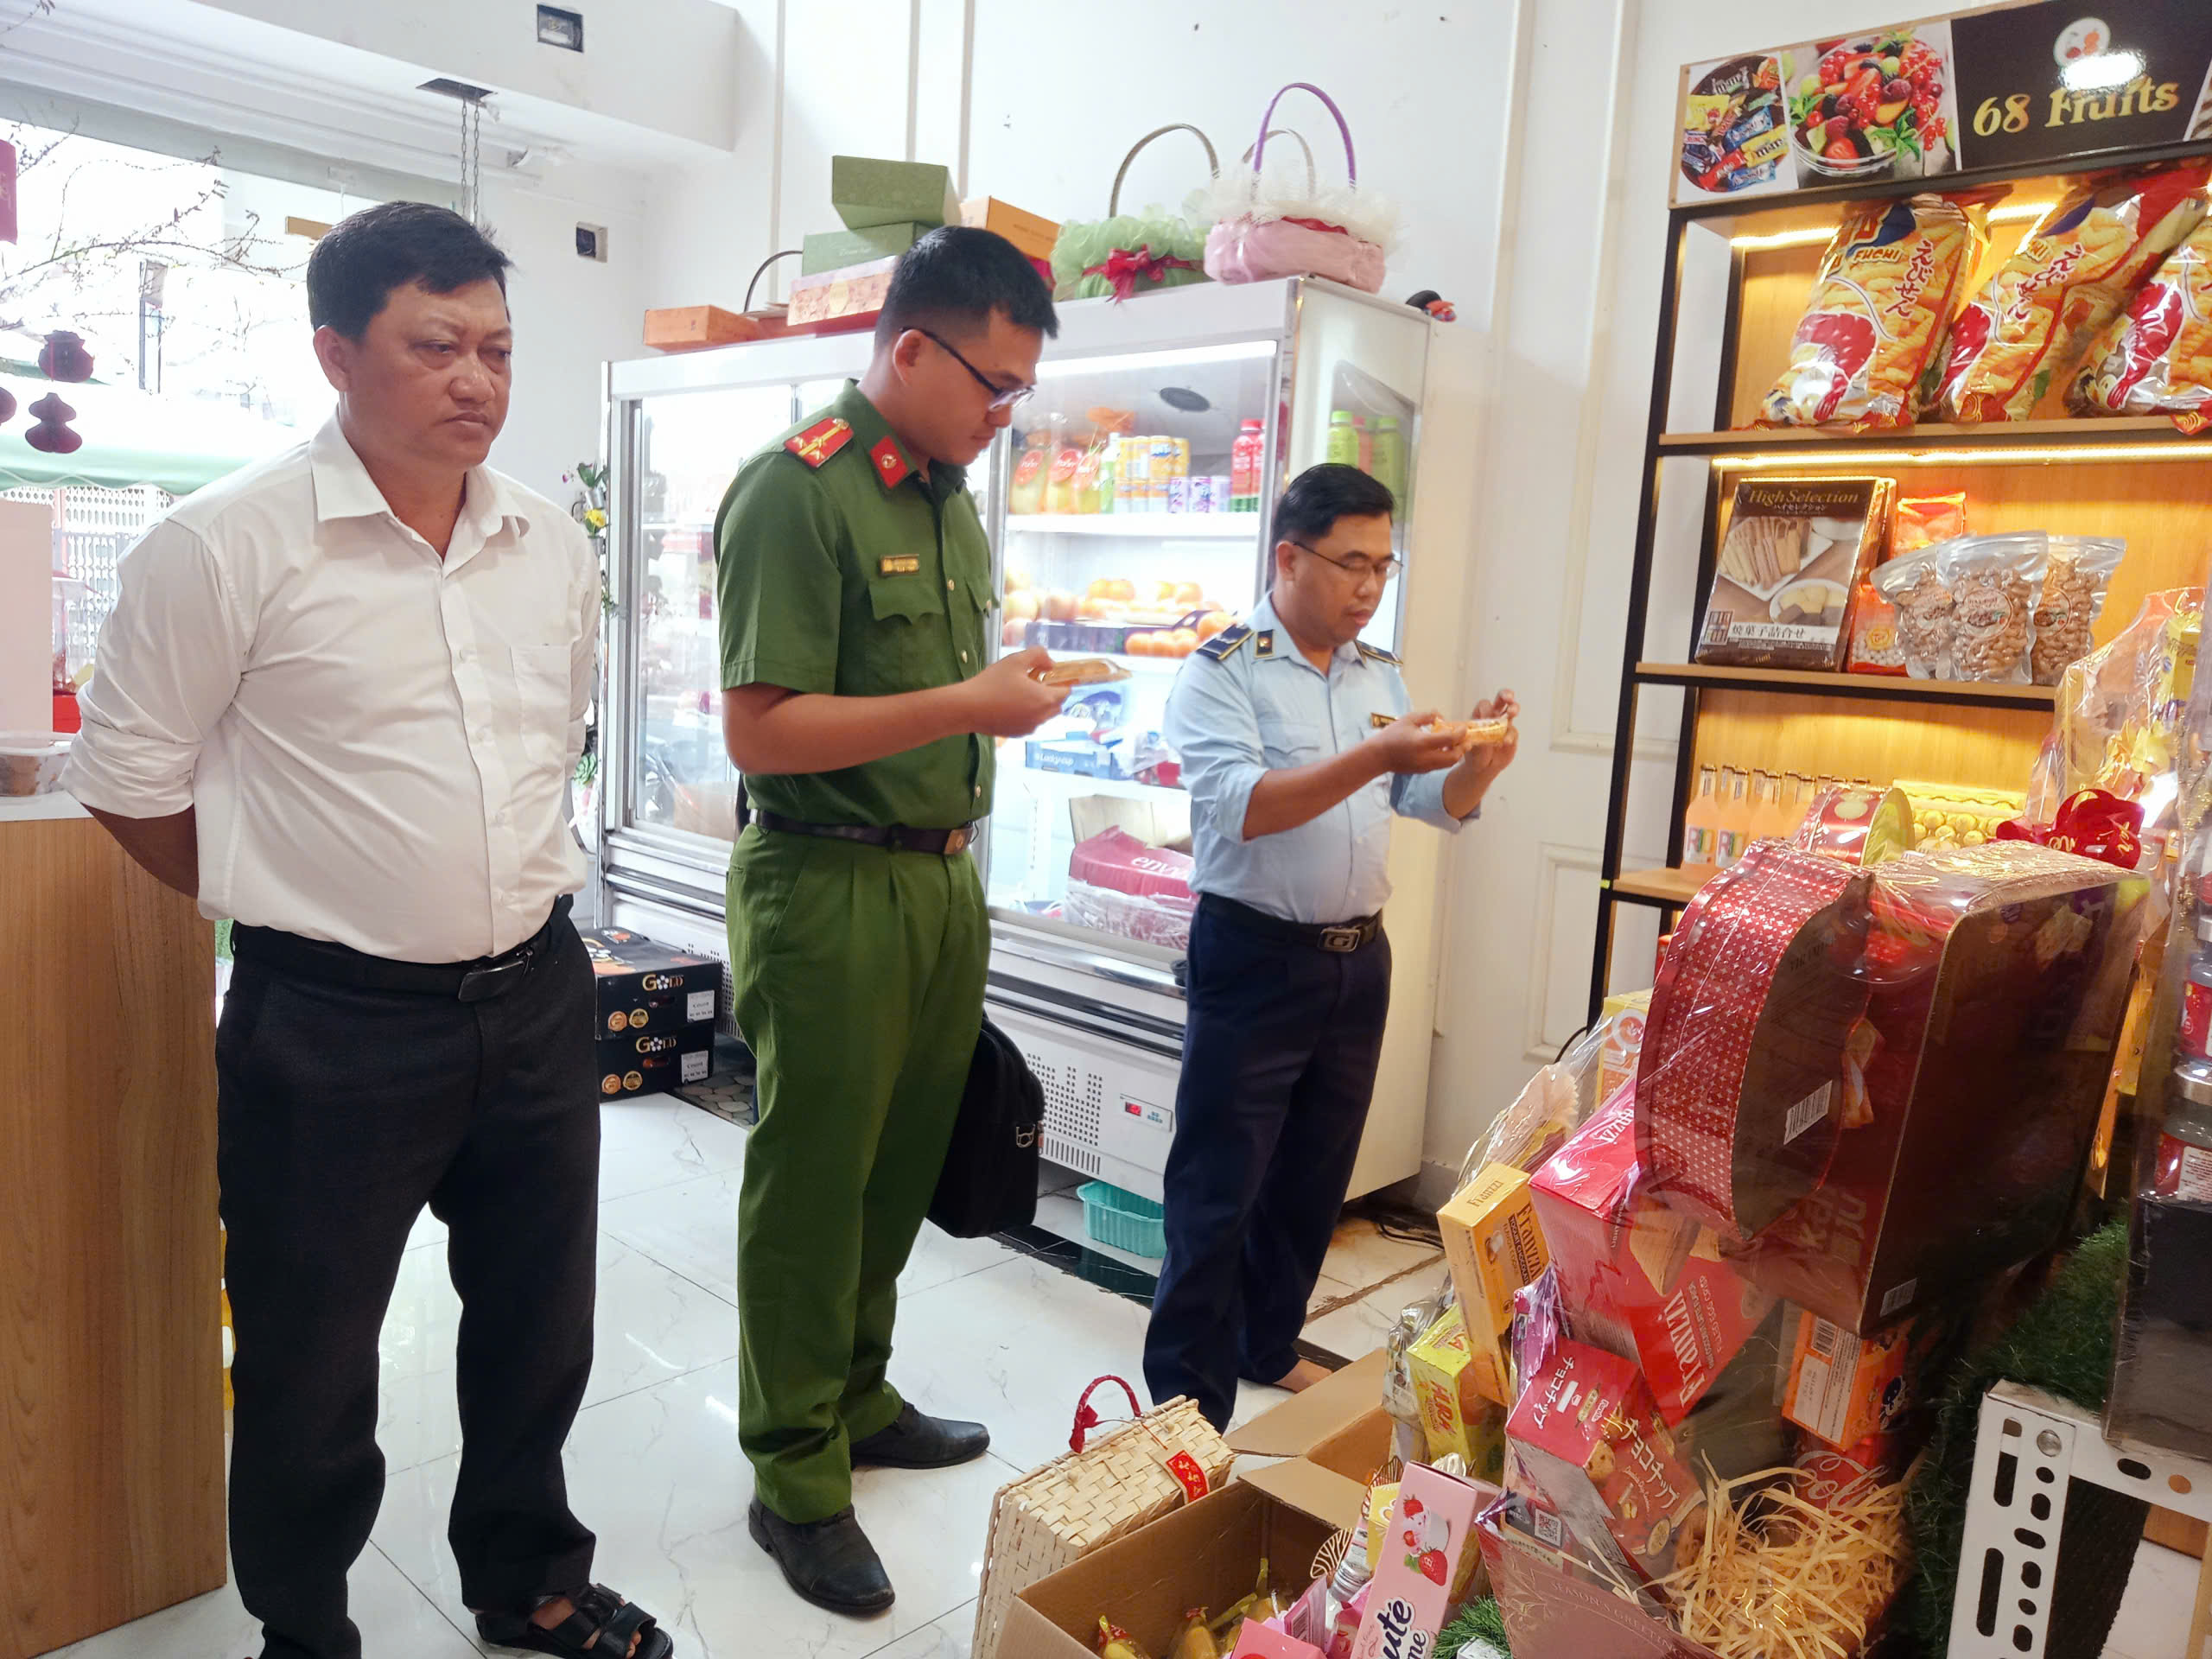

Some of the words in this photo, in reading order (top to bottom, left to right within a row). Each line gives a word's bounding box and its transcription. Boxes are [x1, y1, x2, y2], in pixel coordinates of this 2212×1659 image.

[1973, 92, 2031, 137] 68
[1748, 489, 1785, 506] High
[1786, 489, 1859, 505] Selection
[1516, 1202, 1545, 1280] Franzzi
[1657, 1287, 1706, 1408] Franzzi
[1620, 1417, 1681, 1510] チョコチップ
[1382, 1599, 1412, 1659] uté
